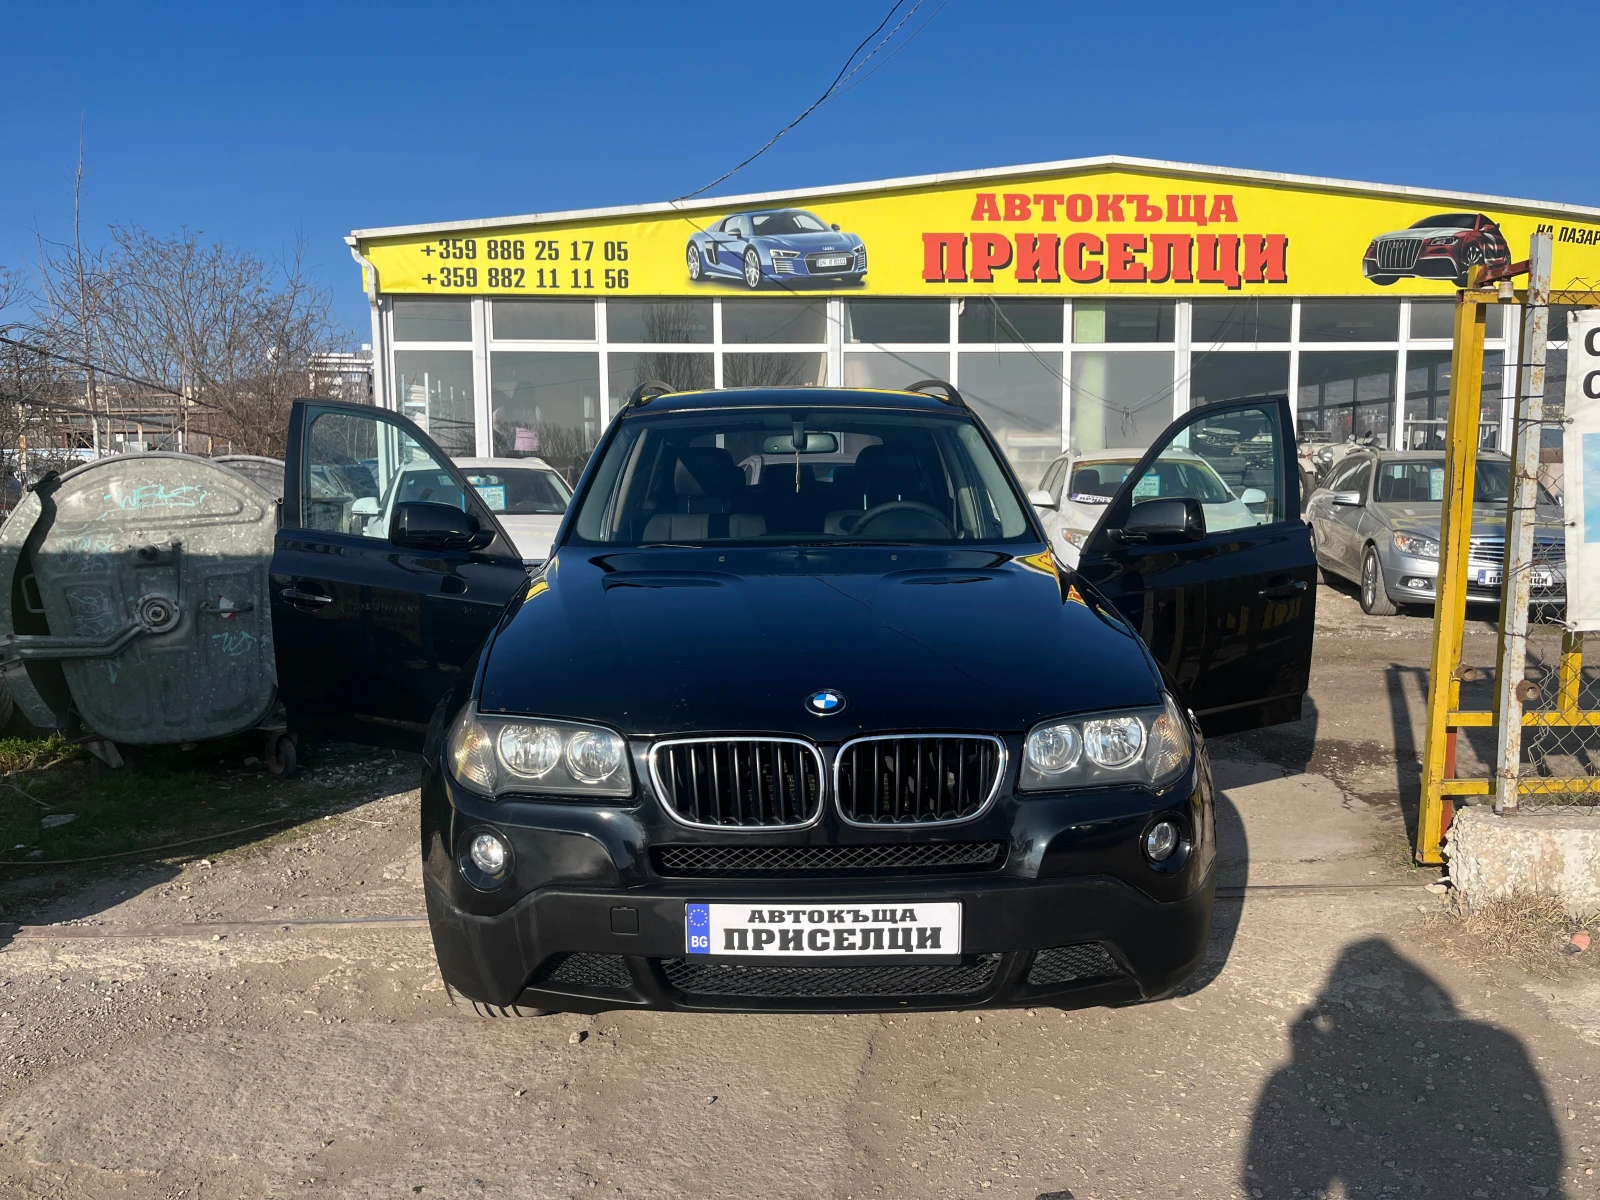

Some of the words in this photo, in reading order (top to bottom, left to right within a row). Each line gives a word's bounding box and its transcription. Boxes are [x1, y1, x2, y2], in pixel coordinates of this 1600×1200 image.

[971, 193, 1238, 226] АВТОКЪЩА
[420, 238, 477, 260] +359
[487, 239, 525, 260] 886
[535, 240, 560, 261] 25
[570, 241, 594, 261] 17
[604, 241, 629, 261] 05
[922, 232, 1288, 290] ПРИСЕЛЦИ
[421, 267, 478, 288] +359
[488, 267, 526, 288] 882
[536, 268, 560, 288] 11
[571, 268, 594, 288] 11
[604, 269, 629, 289] 56
[747, 908, 917, 924] АВТОКЪЩА
[690, 935, 708, 948] BG
[723, 927, 942, 953] ПРИСЕЛЦИ
